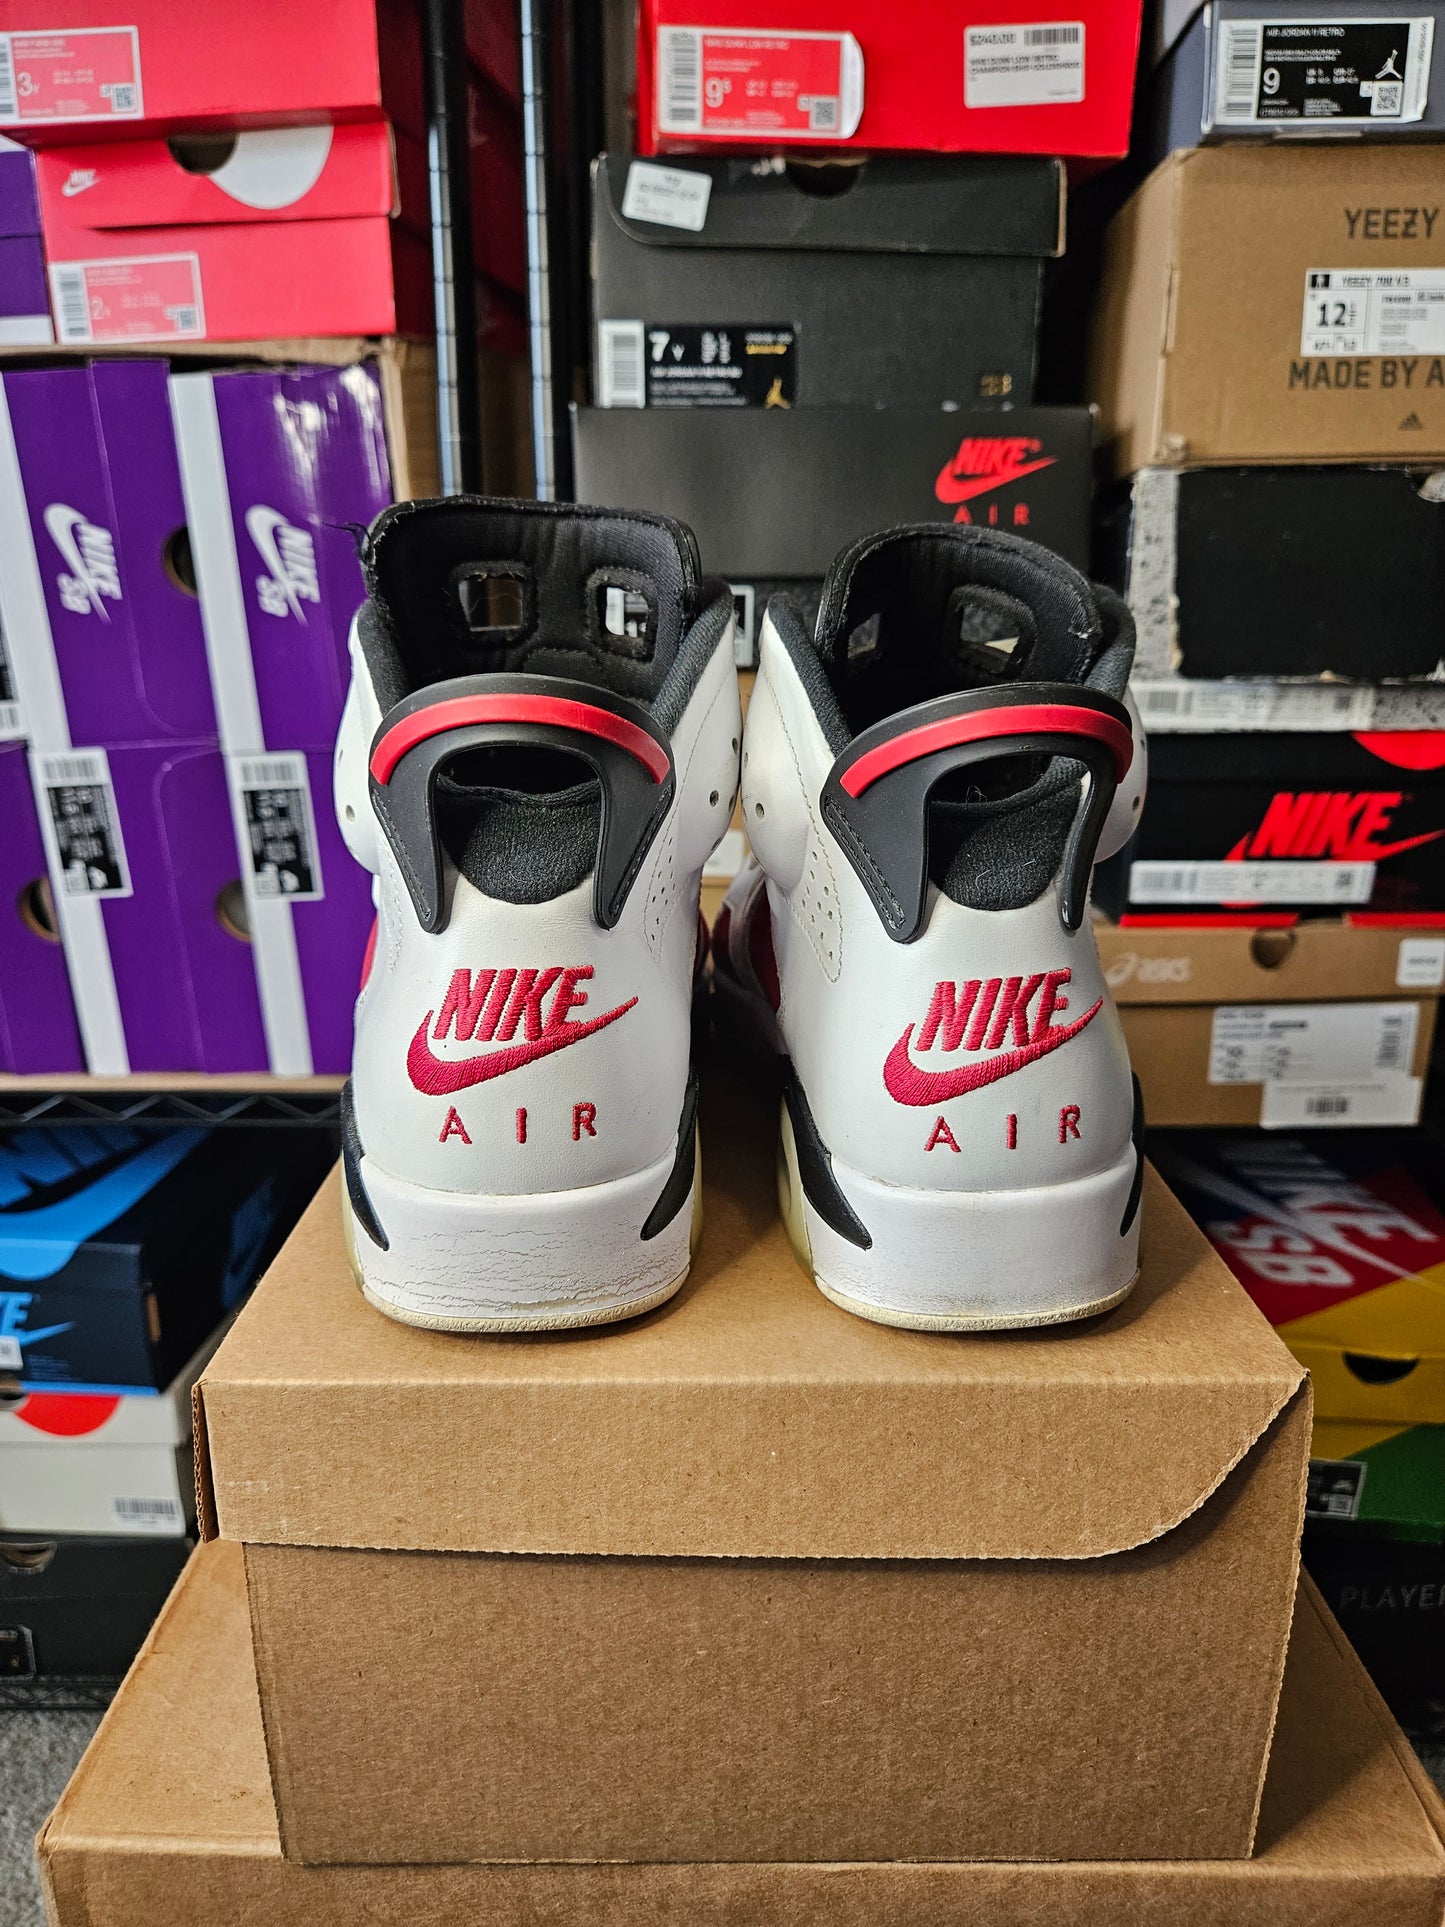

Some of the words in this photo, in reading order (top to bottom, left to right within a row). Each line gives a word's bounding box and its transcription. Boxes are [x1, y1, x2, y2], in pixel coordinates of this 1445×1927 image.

[1263, 67, 1280, 95] 9
[1344, 207, 1439, 239] YEEZY
[1288, 360, 1371, 391] MADE
[1380, 360, 1418, 389] BY
[953, 437, 1031, 476] NIKE
[952, 502, 1030, 526] AIR
[1249, 792, 1402, 859] NIKE
[432, 965, 595, 1042] NIKE
[914, 967, 1073, 1051] NIKE
[438, 1102, 598, 1145] AIR
[923, 1105, 1082, 1152] AIR
[1205, 1220, 1356, 1287] SB
